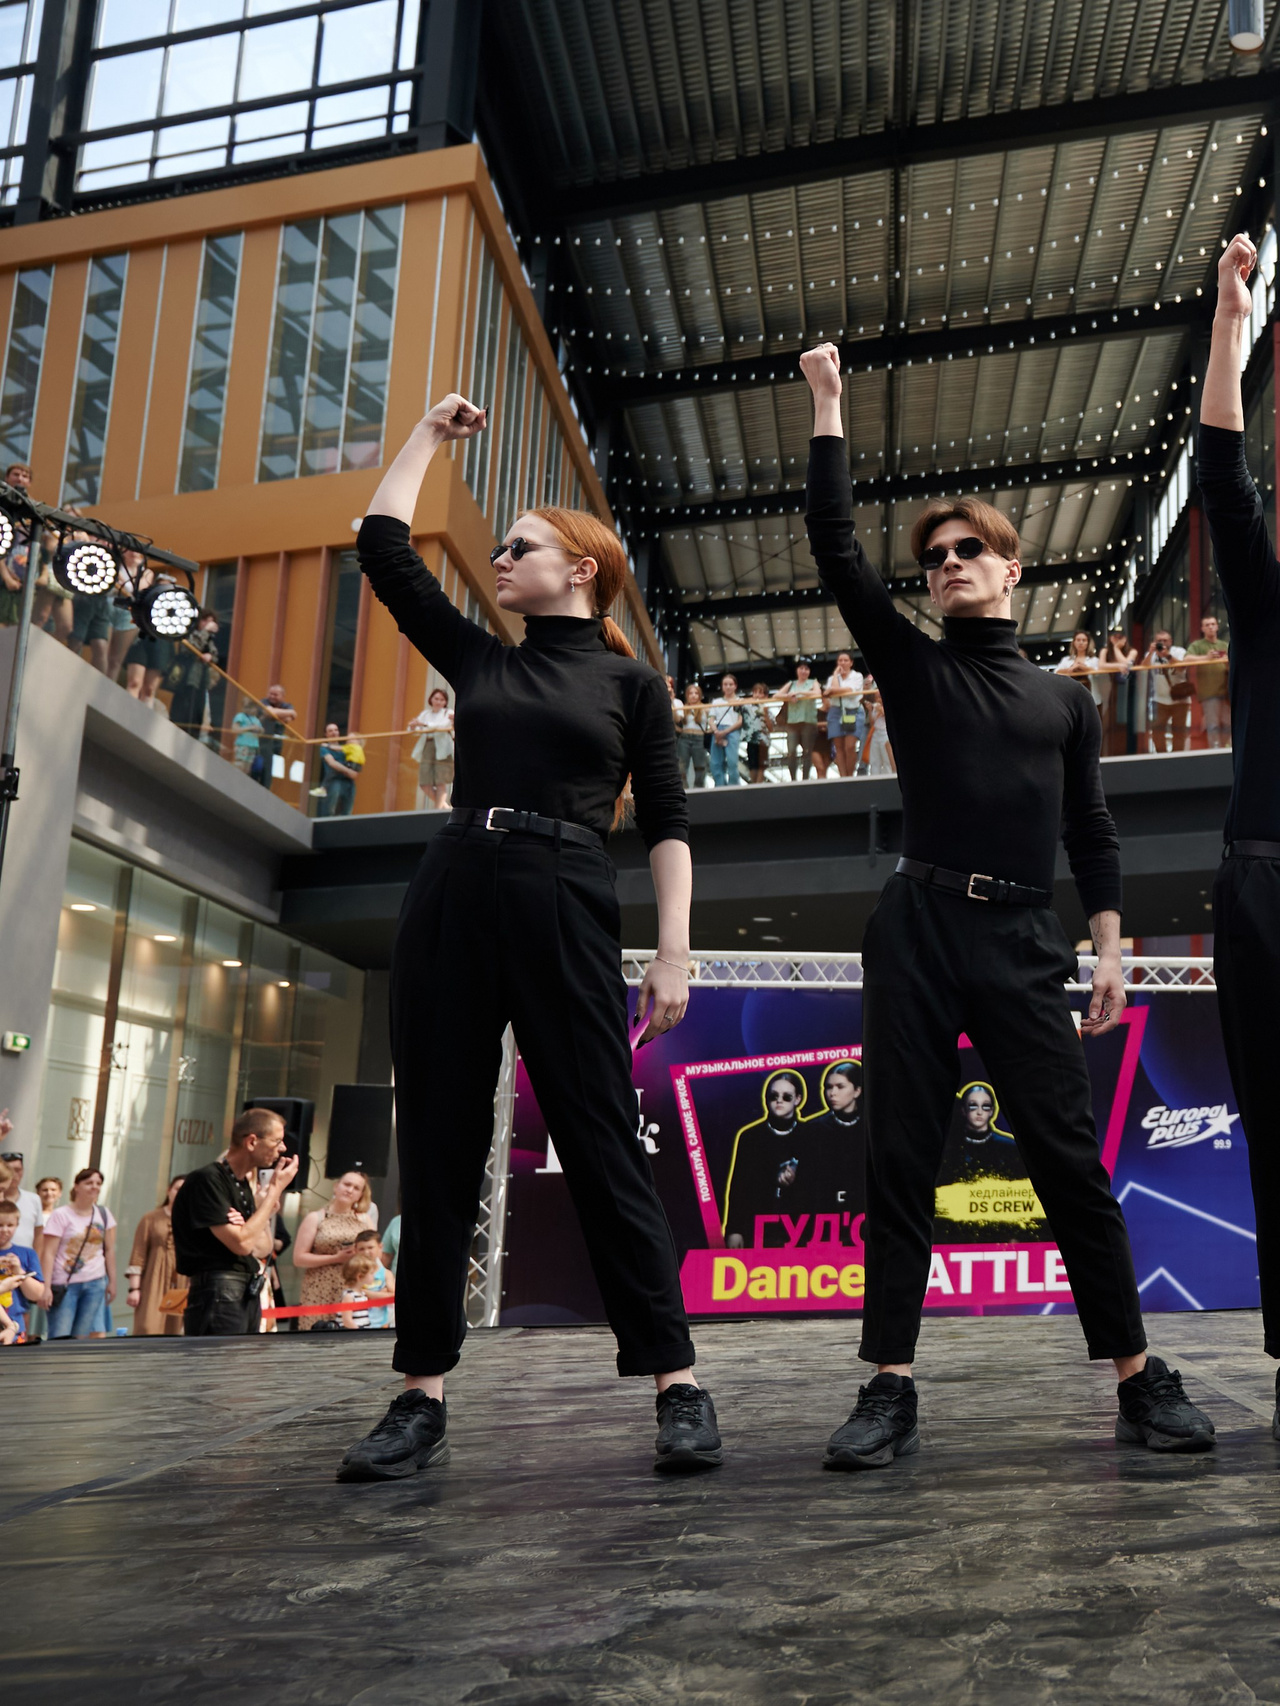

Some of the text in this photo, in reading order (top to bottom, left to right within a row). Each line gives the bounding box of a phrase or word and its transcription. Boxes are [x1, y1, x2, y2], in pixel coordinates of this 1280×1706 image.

[686, 1058, 765, 1076] МУЗЫКАЛЬНОЕ
[767, 1052, 815, 1066] СОБЫТИЕ
[817, 1048, 849, 1060] ЭТОГО
[1141, 1105, 1222, 1130] Europa
[177, 1119, 214, 1146] GIZIA
[676, 1074, 712, 1203] ПОЖАЛУЙ, САМОЕ ЯРКОЕ,
[1213, 1139, 1232, 1150] 99.9
[969, 1201, 1035, 1213] DS CREW
[712, 1250, 1072, 1301] Dance ATTLE
